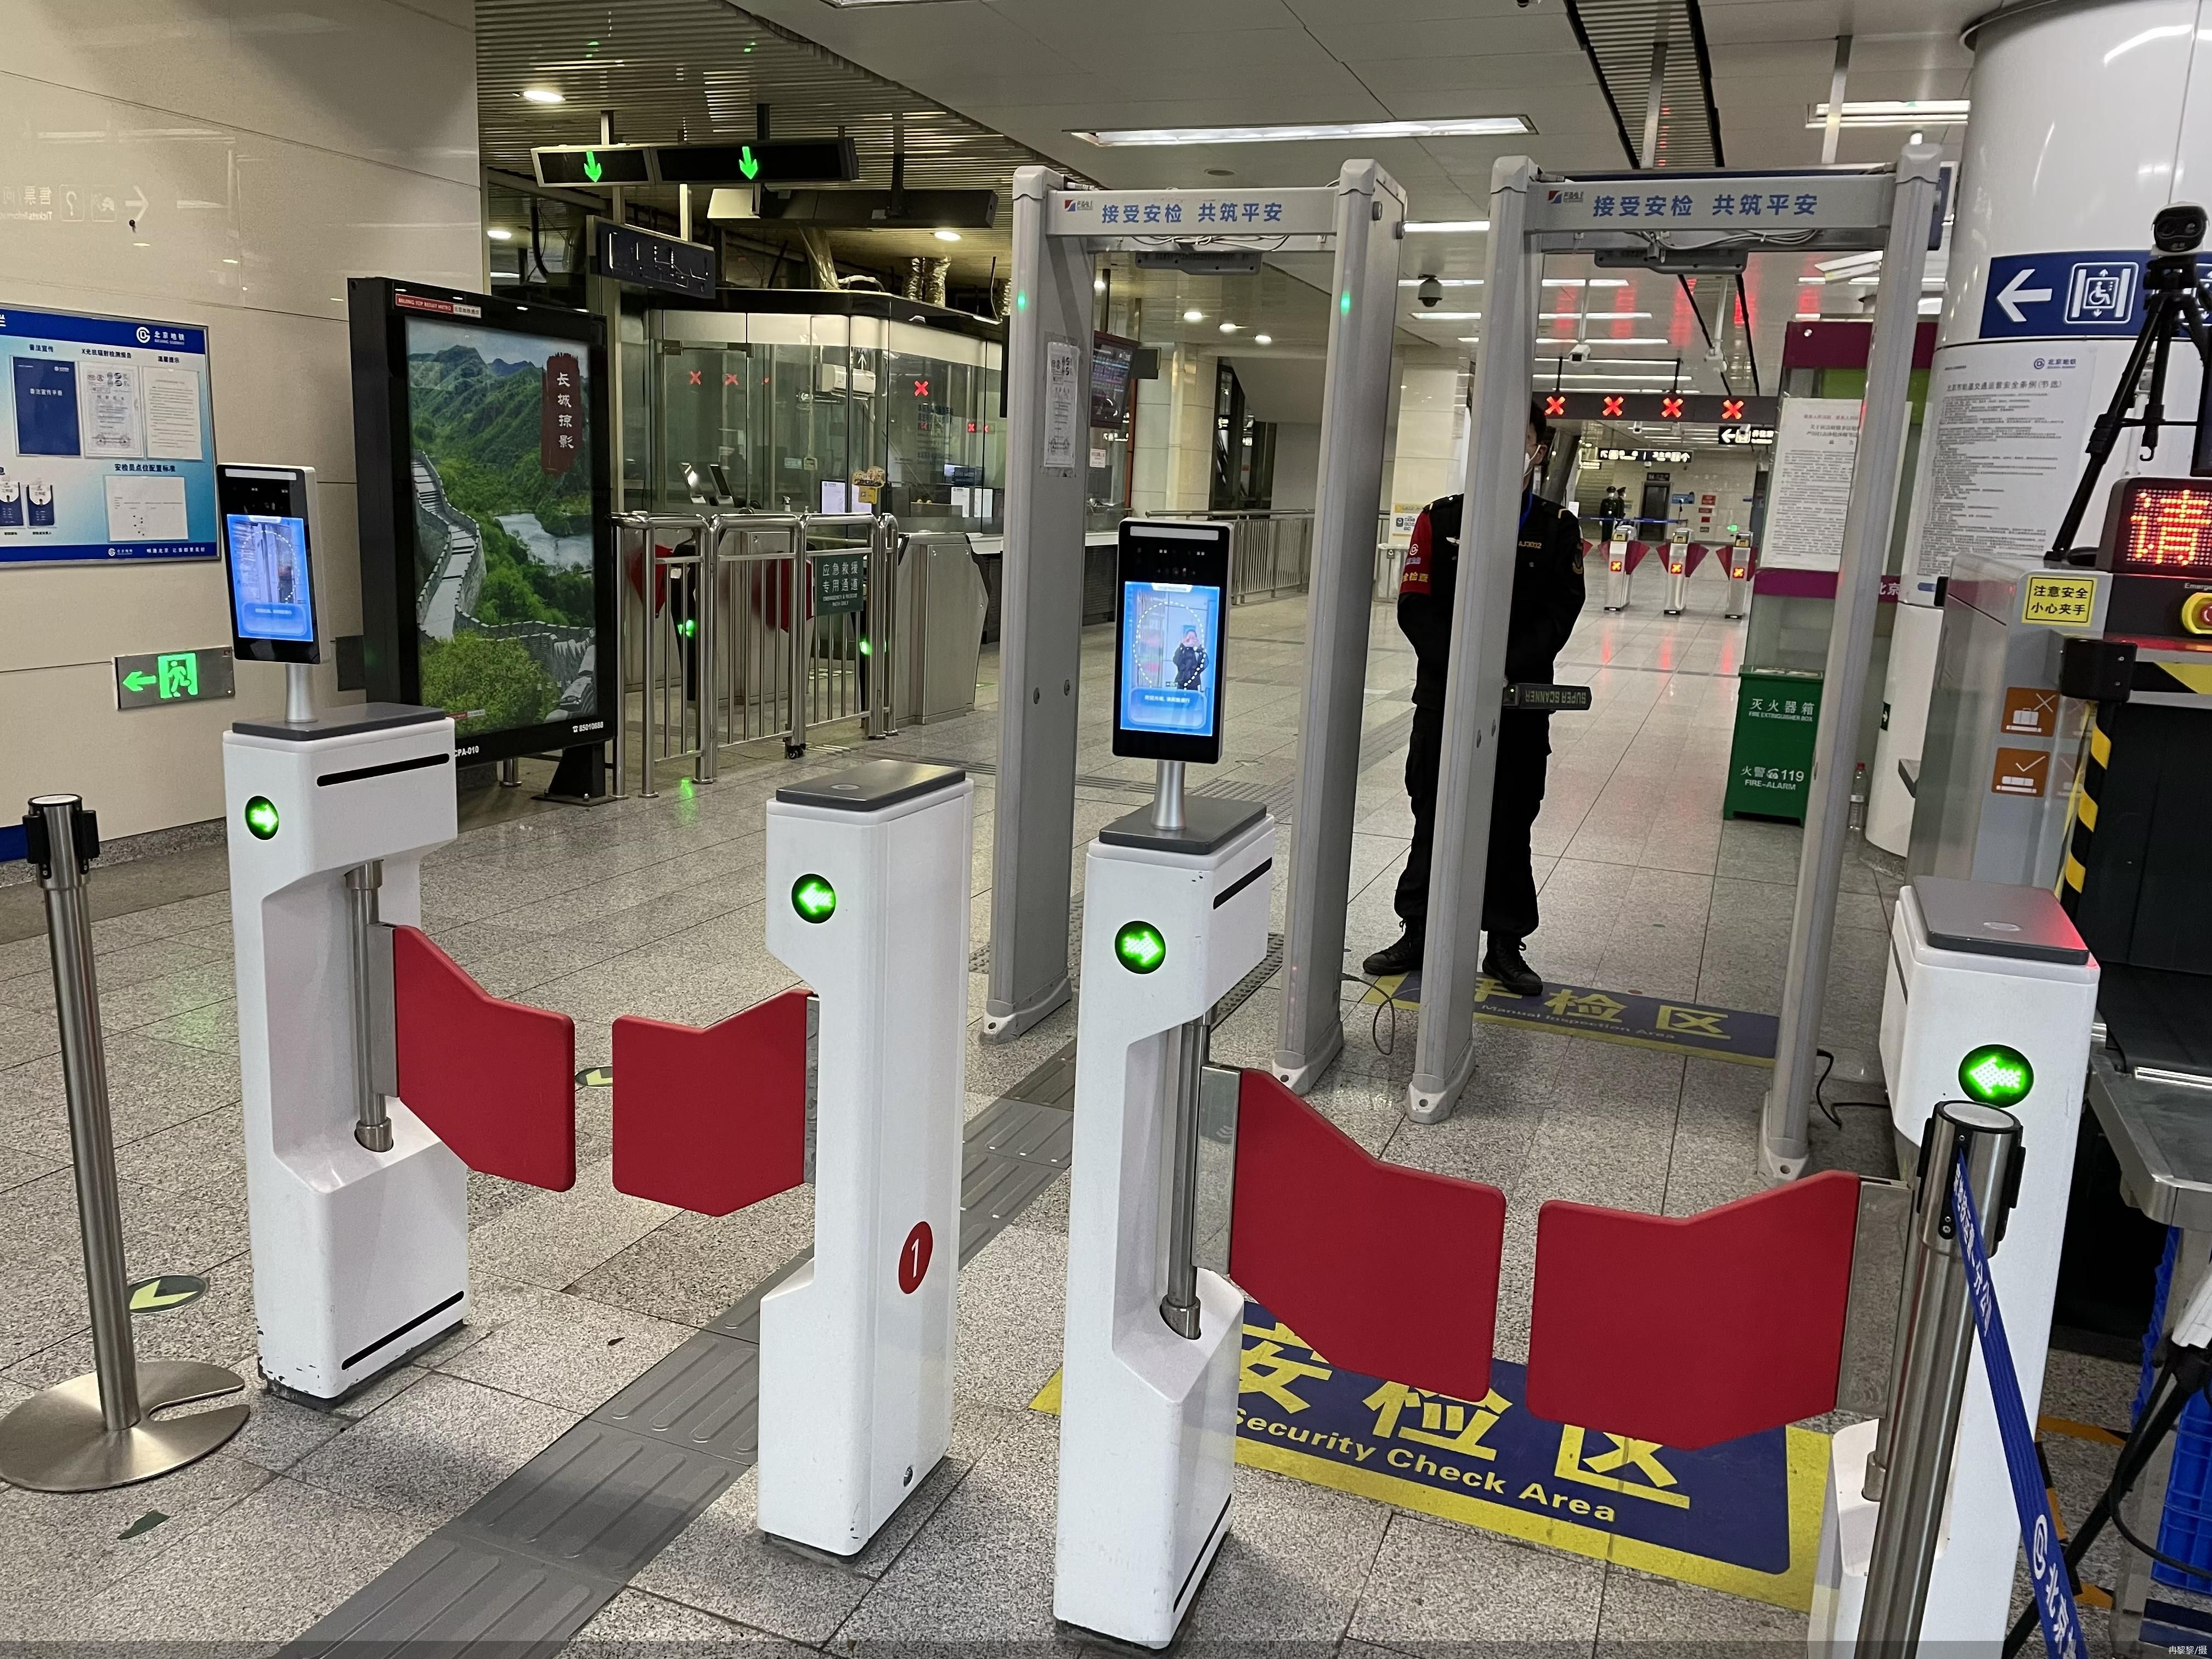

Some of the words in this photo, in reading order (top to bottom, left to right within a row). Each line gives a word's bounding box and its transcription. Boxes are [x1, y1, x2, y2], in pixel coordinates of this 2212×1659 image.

[1102, 203, 1182, 224] 接受安检
[1198, 202, 1283, 223] 共筑平安
[1593, 194, 1694, 217] 接受安检
[1712, 193, 1818, 216] 共筑平安
[556, 371, 574, 449] 长城掠影
[2130, 489, 2212, 566] 请
[822, 561, 858, 577] 应急救援
[822, 577, 858, 593] 专用通道
[2033, 585, 2089, 599] 注意安全
[2031, 602, 2086, 616] 小心夹手
[1525, 690, 1560, 703] SCANNER
[1561, 691, 1587, 704] SUPER
[1750, 698, 1815, 715] 灭火器箱
[1781, 770, 1804, 782] 119
[1745, 779, 1796, 791] FIRE-ALARM
[1481, 1005, 1541, 1018] Manual
[1545, 1014, 1631, 1032] Inspection
[1635, 1029, 1676, 1040] Area
[911, 1238, 919, 1278] 1
[1235, 1407, 1376, 1462] Security
[1386, 1448, 1506, 1494] Check
[1518, 1483, 1616, 1522] Area
